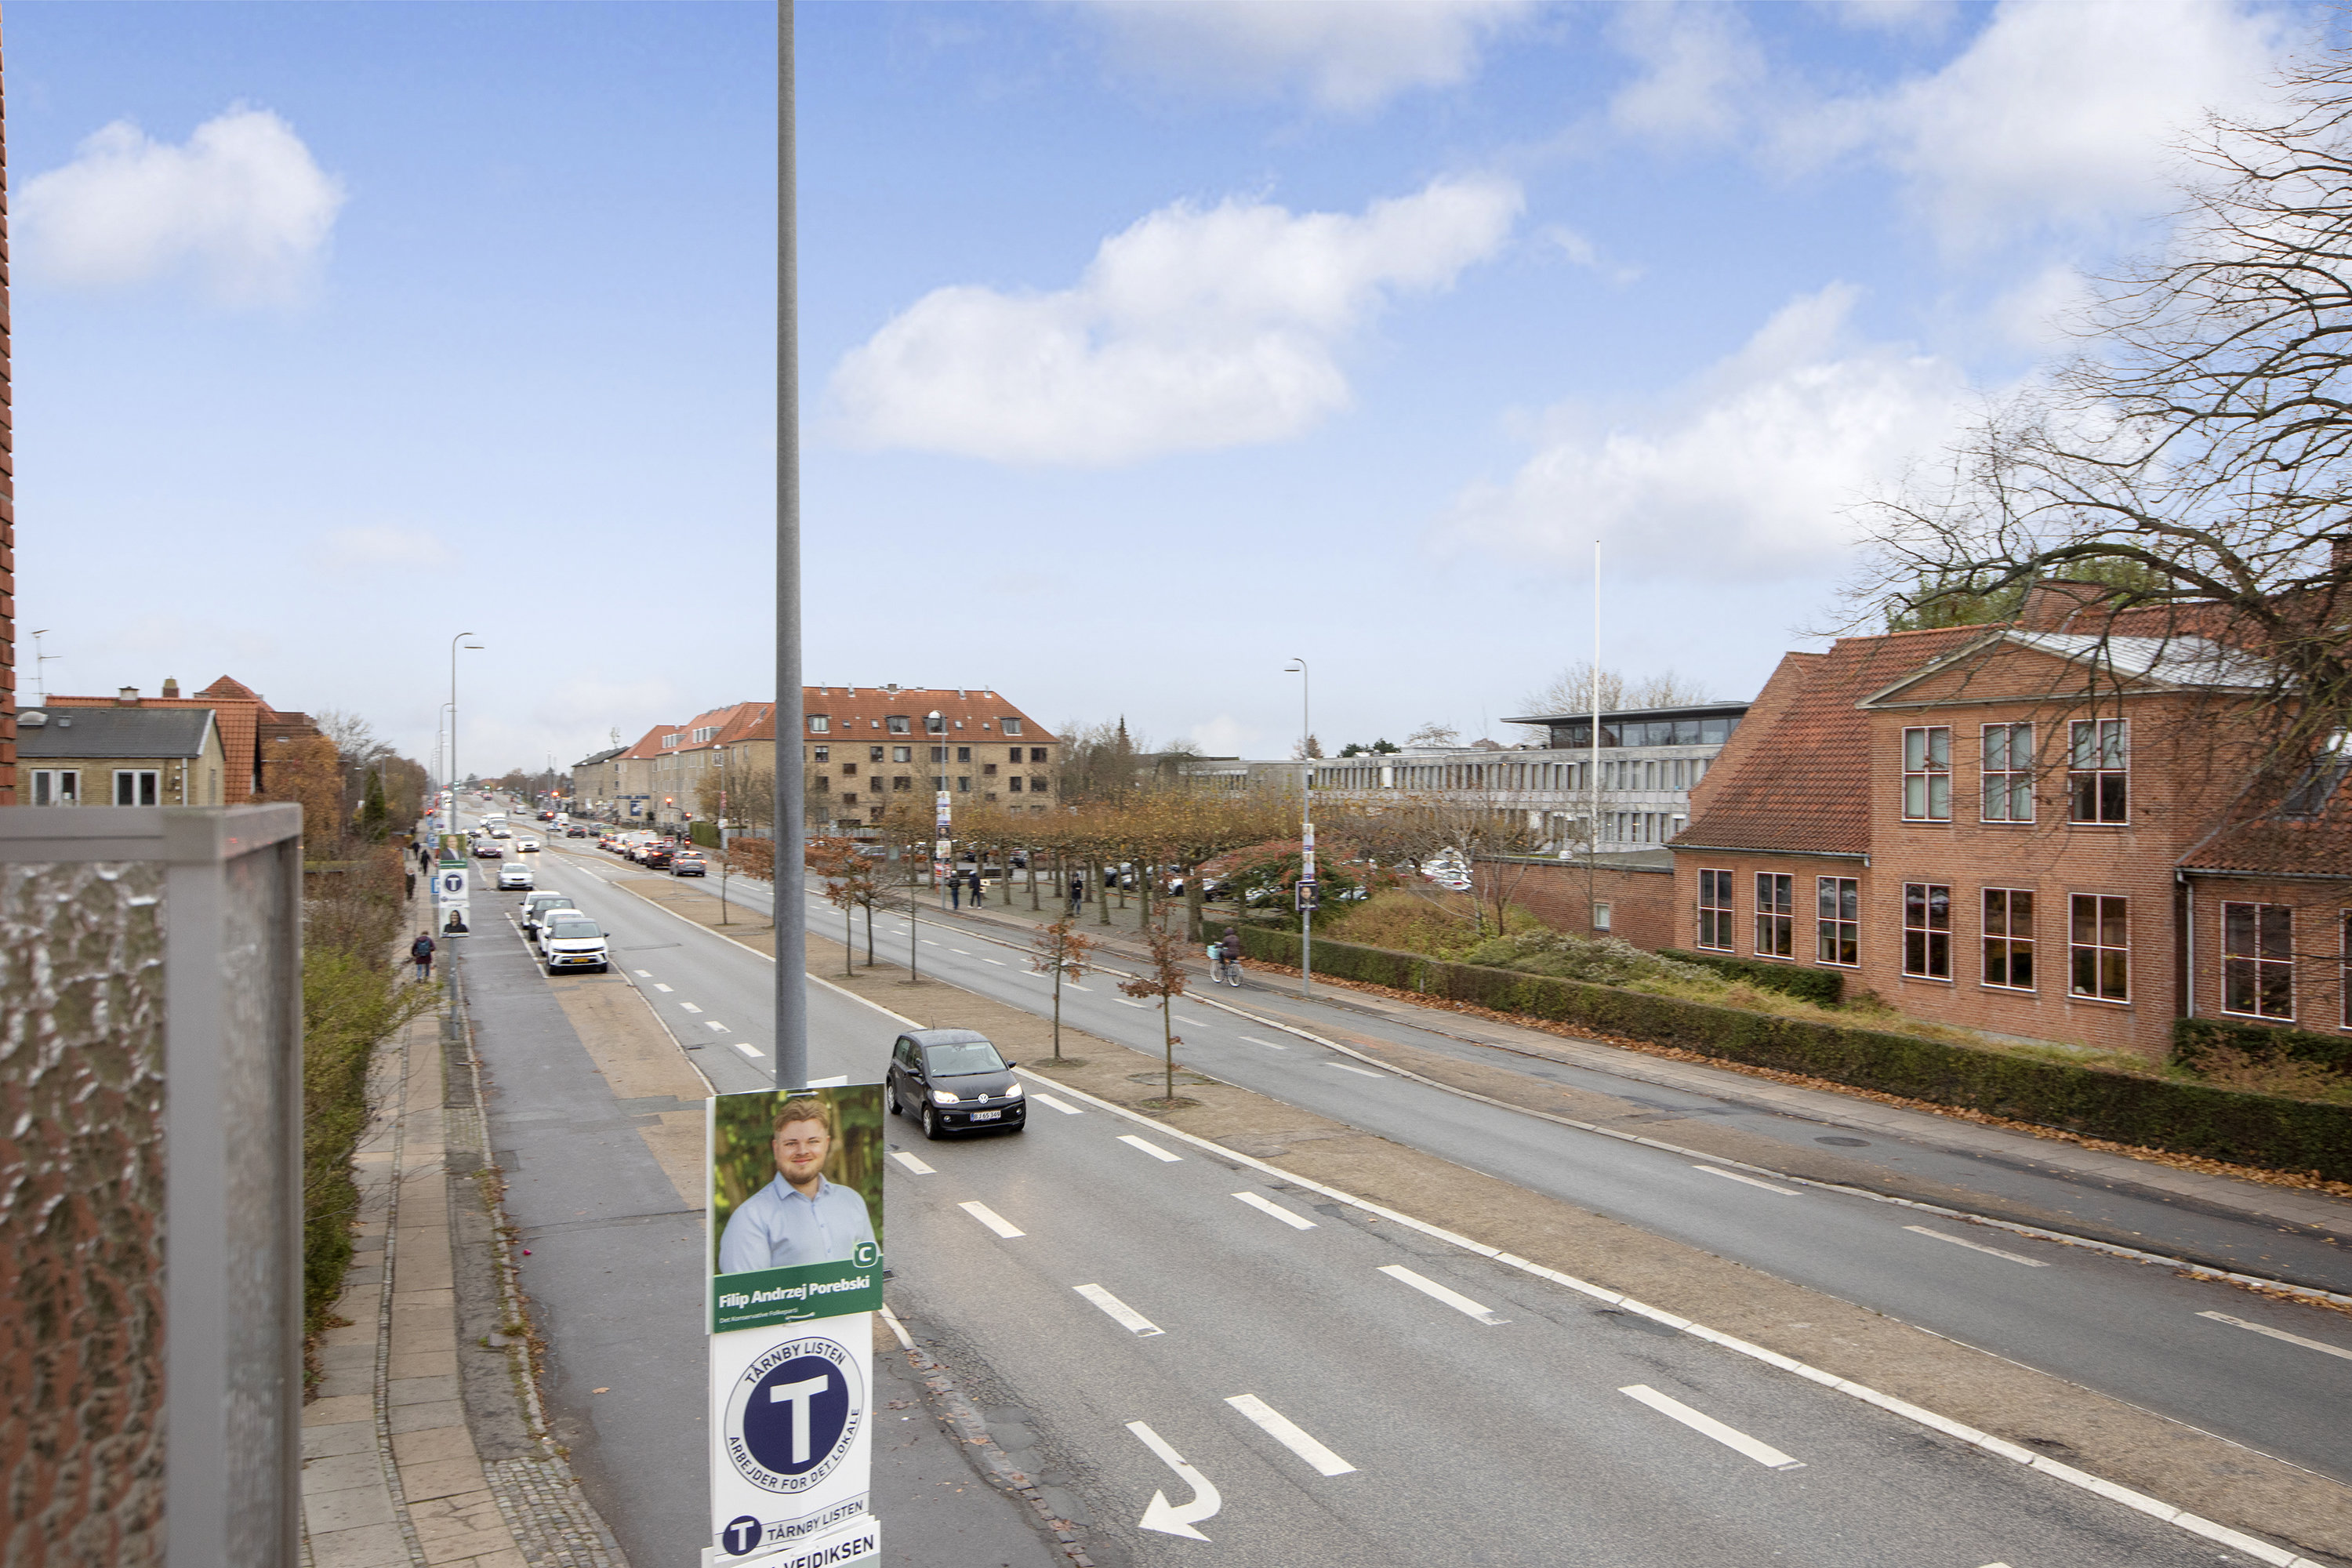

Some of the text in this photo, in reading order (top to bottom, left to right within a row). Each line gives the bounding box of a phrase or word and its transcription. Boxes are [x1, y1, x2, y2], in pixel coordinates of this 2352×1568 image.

[858, 1247, 872, 1261] C
[719, 1275, 870, 1308] Filip Andrzej Porebski
[745, 1342, 846, 1385] TÅRNBY LISTEN
[770, 1374, 829, 1465] T
[729, 1408, 860, 1490] ARBEJDER FOR DET LOKALE
[730, 1500, 863, 1552] T TÅRNBY LISTEN
